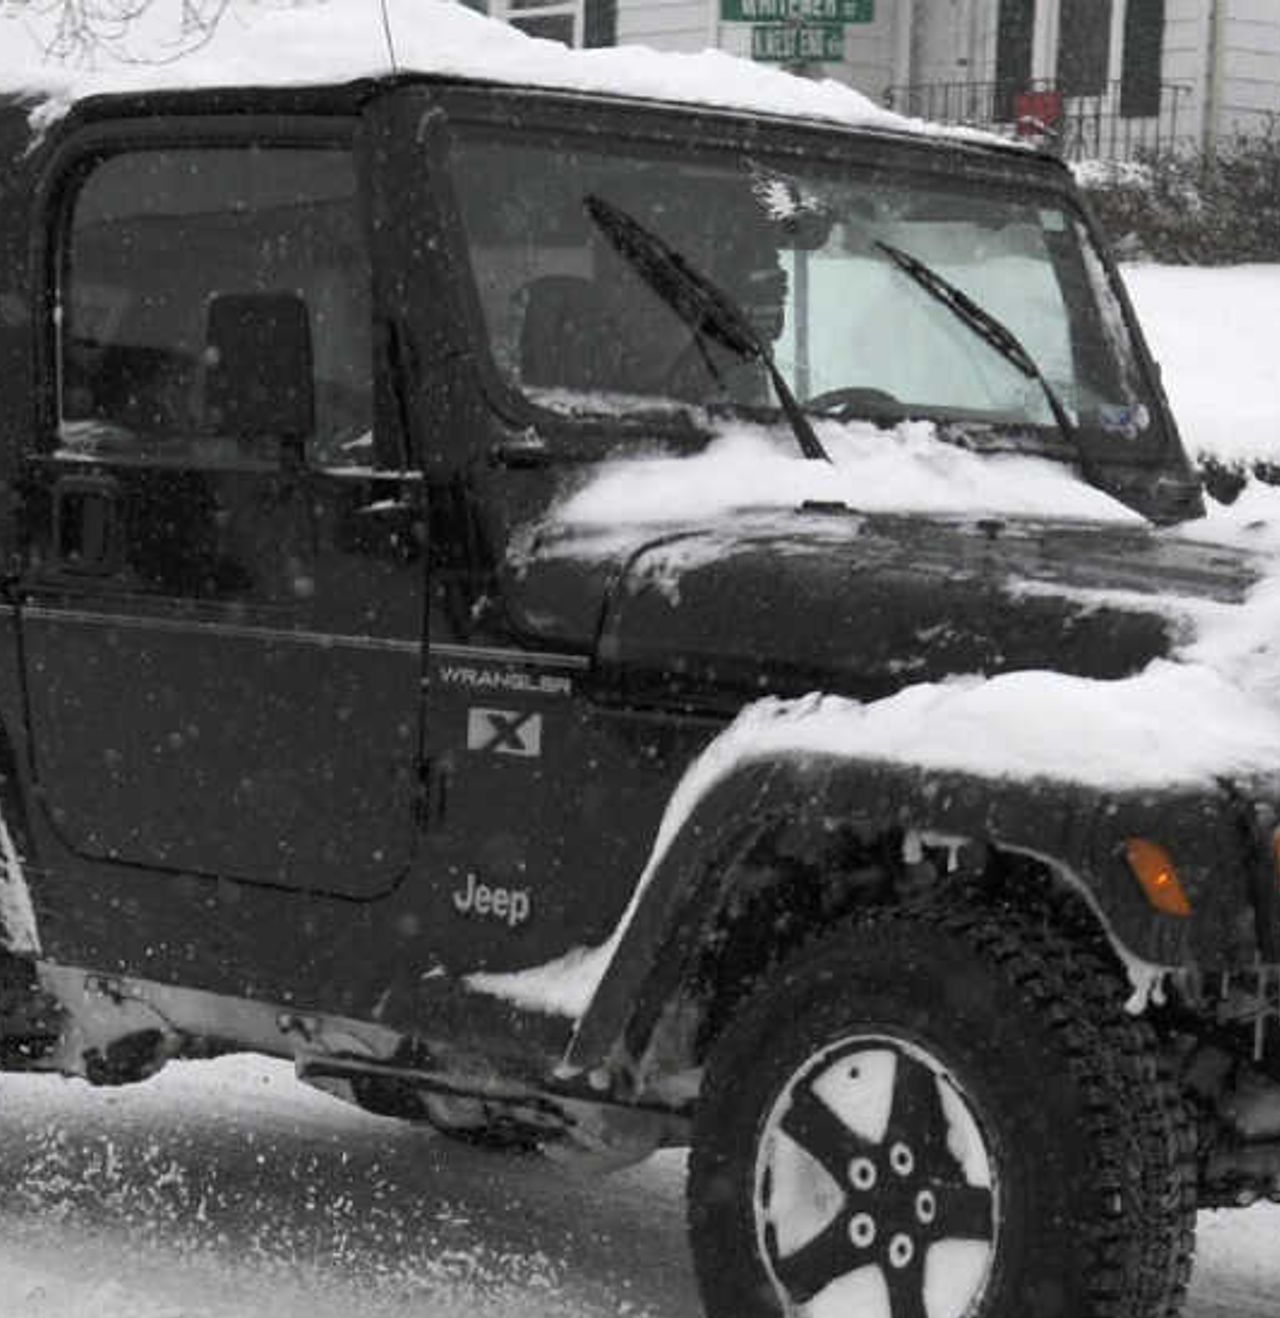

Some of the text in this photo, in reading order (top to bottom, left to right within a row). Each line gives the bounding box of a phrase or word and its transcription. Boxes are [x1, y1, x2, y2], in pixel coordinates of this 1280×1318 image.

[440, 666, 571, 694] WRANGLER
[478, 708, 538, 754] X
[454, 874, 529, 925] Jeep
